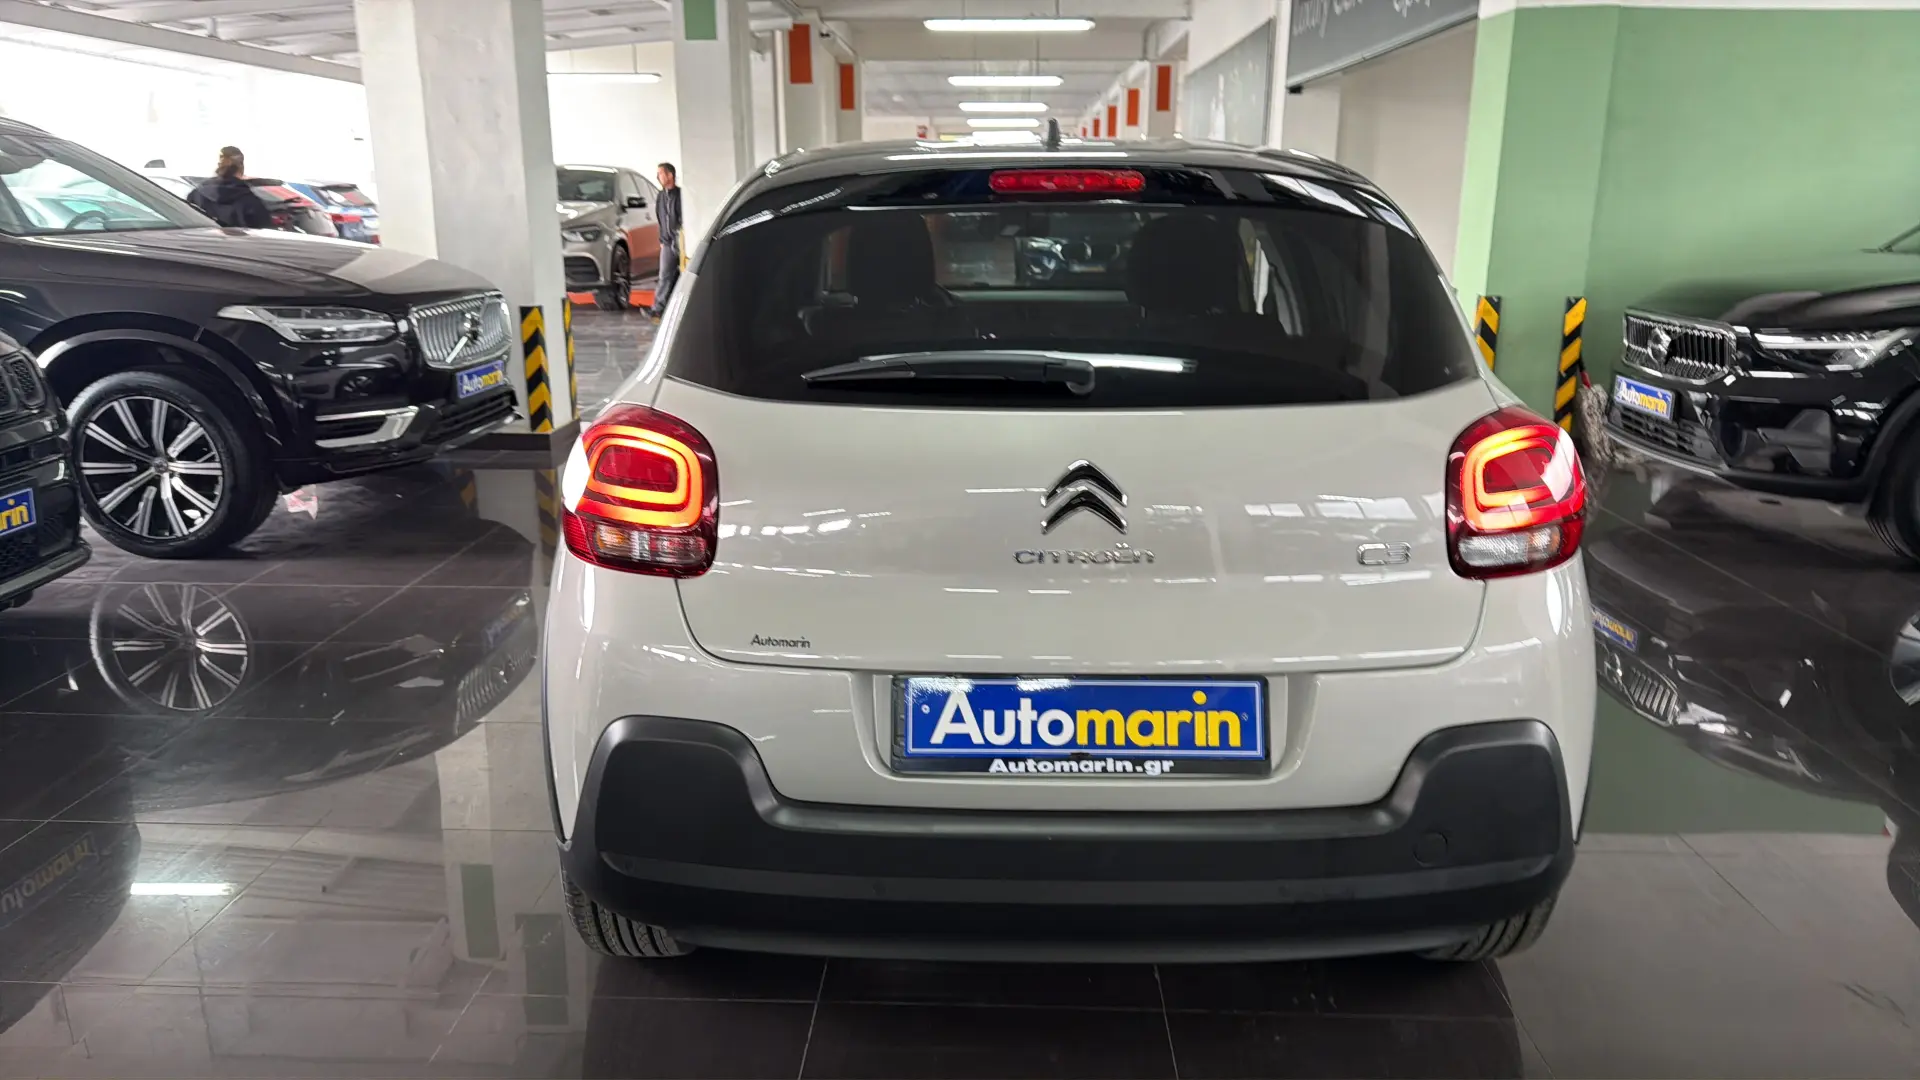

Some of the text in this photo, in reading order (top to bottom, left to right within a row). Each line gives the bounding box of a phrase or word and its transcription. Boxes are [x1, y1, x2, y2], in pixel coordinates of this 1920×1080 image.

[1357, 541, 1412, 566] C3
[750, 633, 811, 648] Automarin
[929, 690, 1242, 748] Automarin
[988, 757, 1175, 776] Automarin.gr
